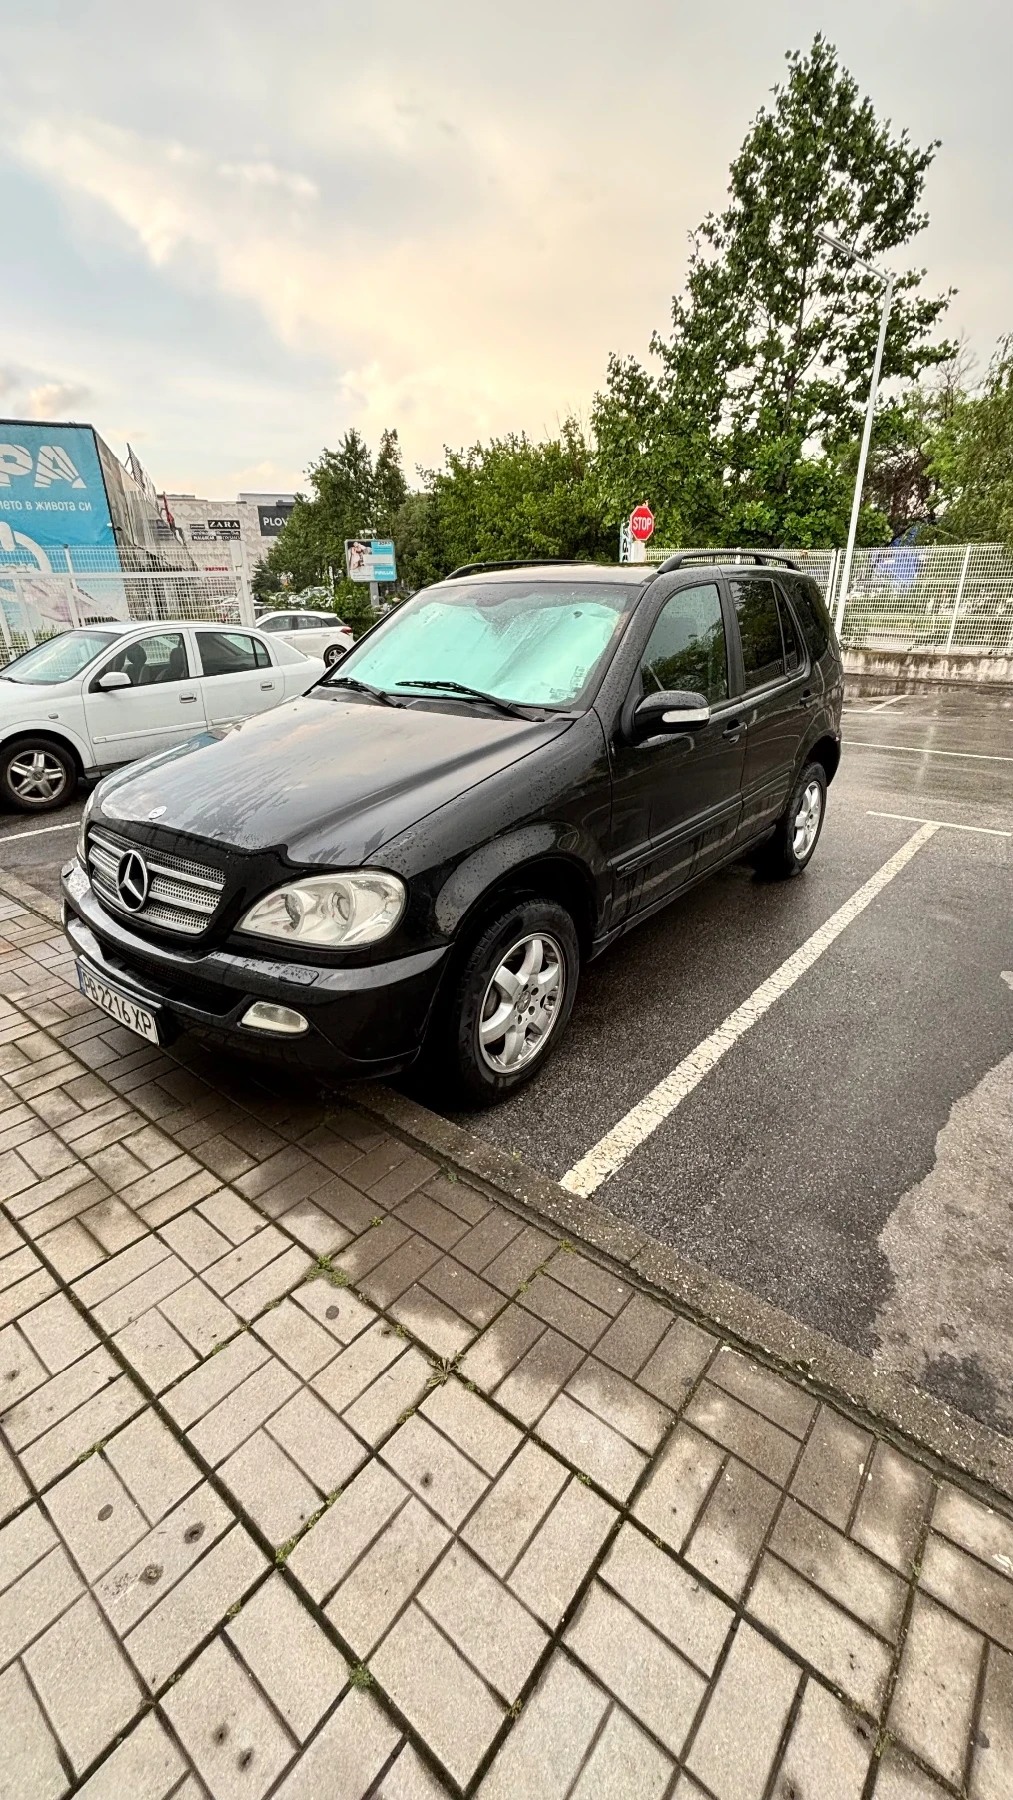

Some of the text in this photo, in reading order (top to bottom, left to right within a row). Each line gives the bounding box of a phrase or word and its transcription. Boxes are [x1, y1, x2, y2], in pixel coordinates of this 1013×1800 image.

[25, 501, 33, 511] в
[35, 501, 76, 512] живота
[78, 501, 92, 512] си
[632, 516, 652, 531] STOP
